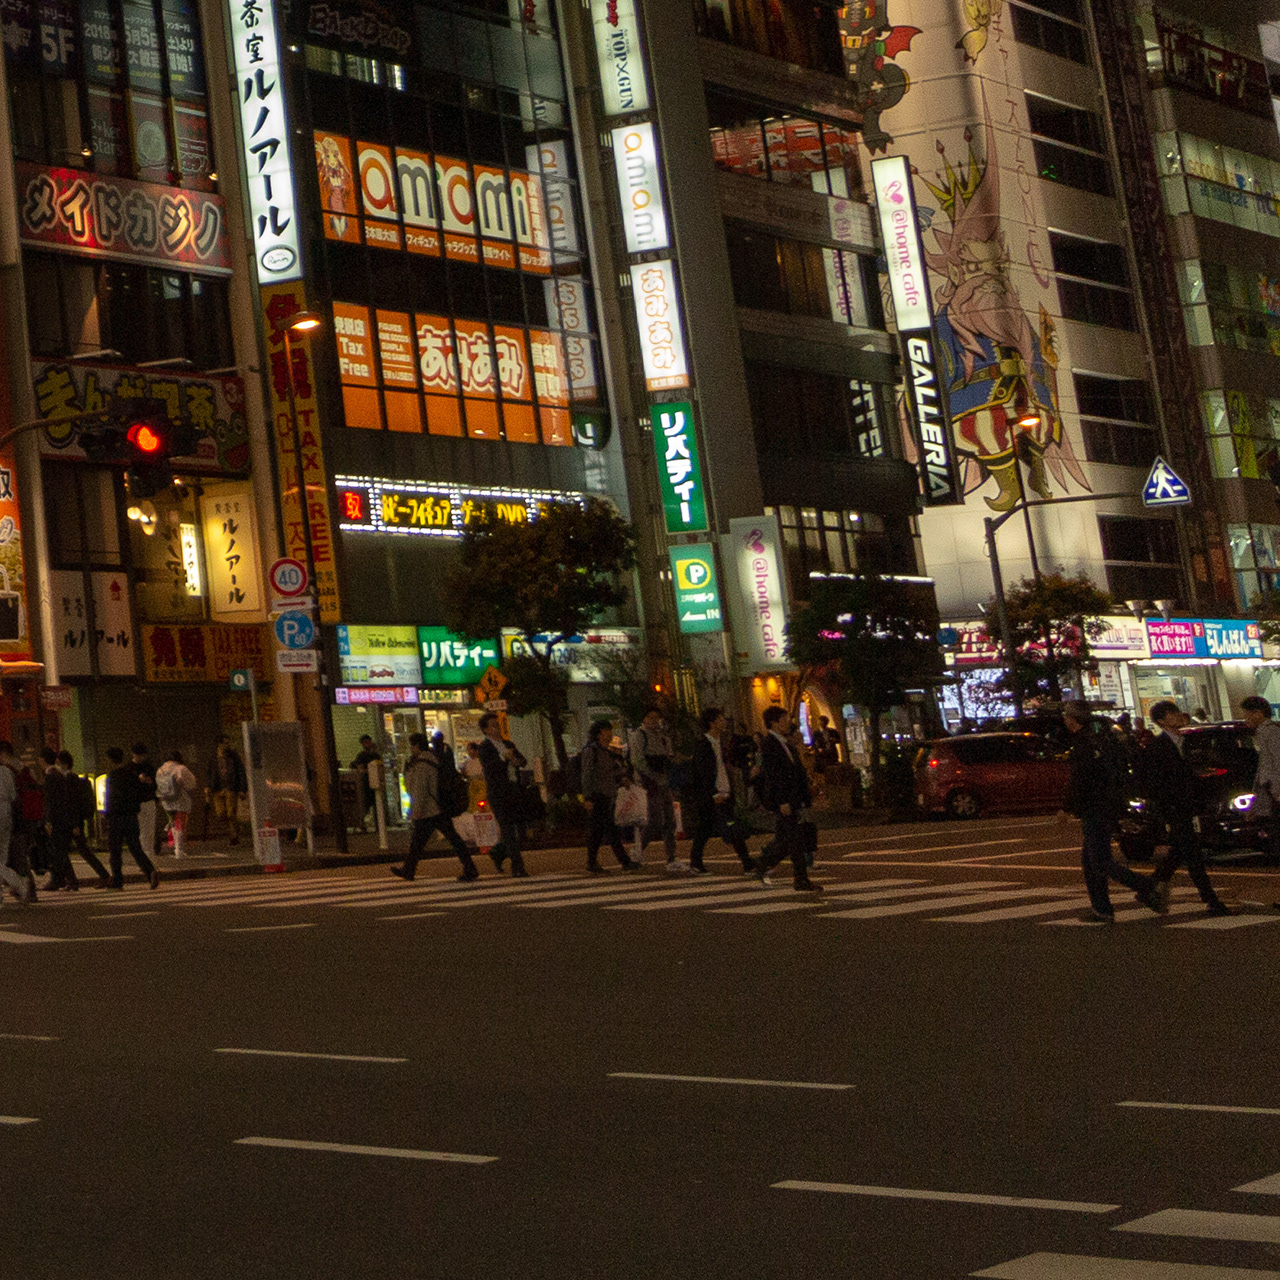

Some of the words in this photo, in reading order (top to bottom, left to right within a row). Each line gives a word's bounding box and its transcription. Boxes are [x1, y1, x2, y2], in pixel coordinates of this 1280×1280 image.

[40, 25, 75, 64] 5F
[623, 132, 658, 247] amiami
[22, 174, 221, 261] メイドカジノ
[891, 208, 913, 269] @home
[898, 271, 920, 308] cafe
[639, 269, 676, 371] あみあみ
[340, 337, 365, 357] Tax
[416, 324, 524, 398] あみあみ
[340, 358, 370, 379] Free
[906, 337, 951, 499] GALLERIA
[659, 411, 694, 524] リバティー
[221, 519, 246, 606] ルノアール
[278, 568, 299, 586] 40
[751, 557, 773, 622] @home
[282, 620, 299, 645] P
[706, 607, 721, 620] IN
[422, 640, 495, 669] リバティー
[760, 623, 780, 660] cafe
[1206, 628, 1251, 656] らしんばん
